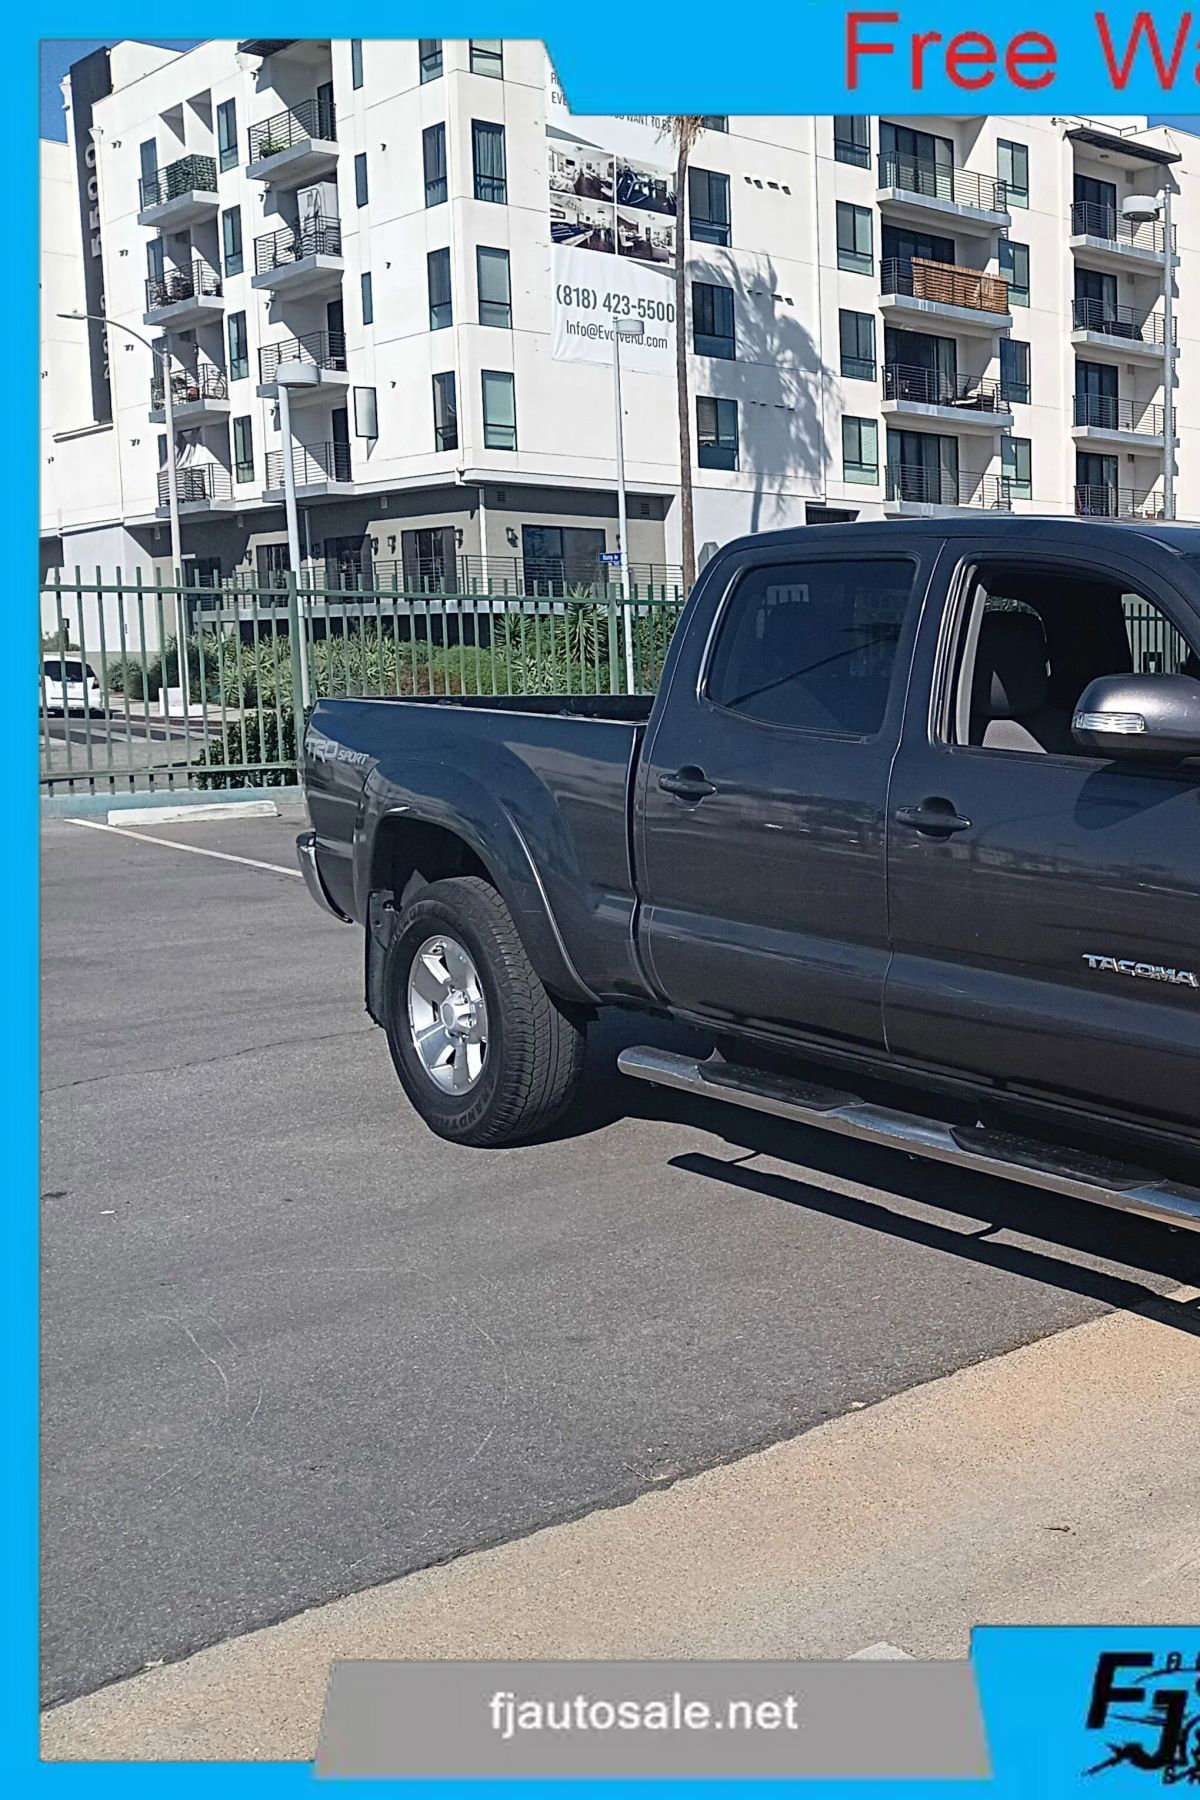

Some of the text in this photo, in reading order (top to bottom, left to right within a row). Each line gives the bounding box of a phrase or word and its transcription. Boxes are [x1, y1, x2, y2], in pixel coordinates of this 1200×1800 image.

[556, 284, 676, 323] (818) 423-5500
[566, 319, 669, 349] Info@EvoveRD.com
[337, 749, 370, 765] SPORT
[1081, 953, 1200, 988] TACOMA
